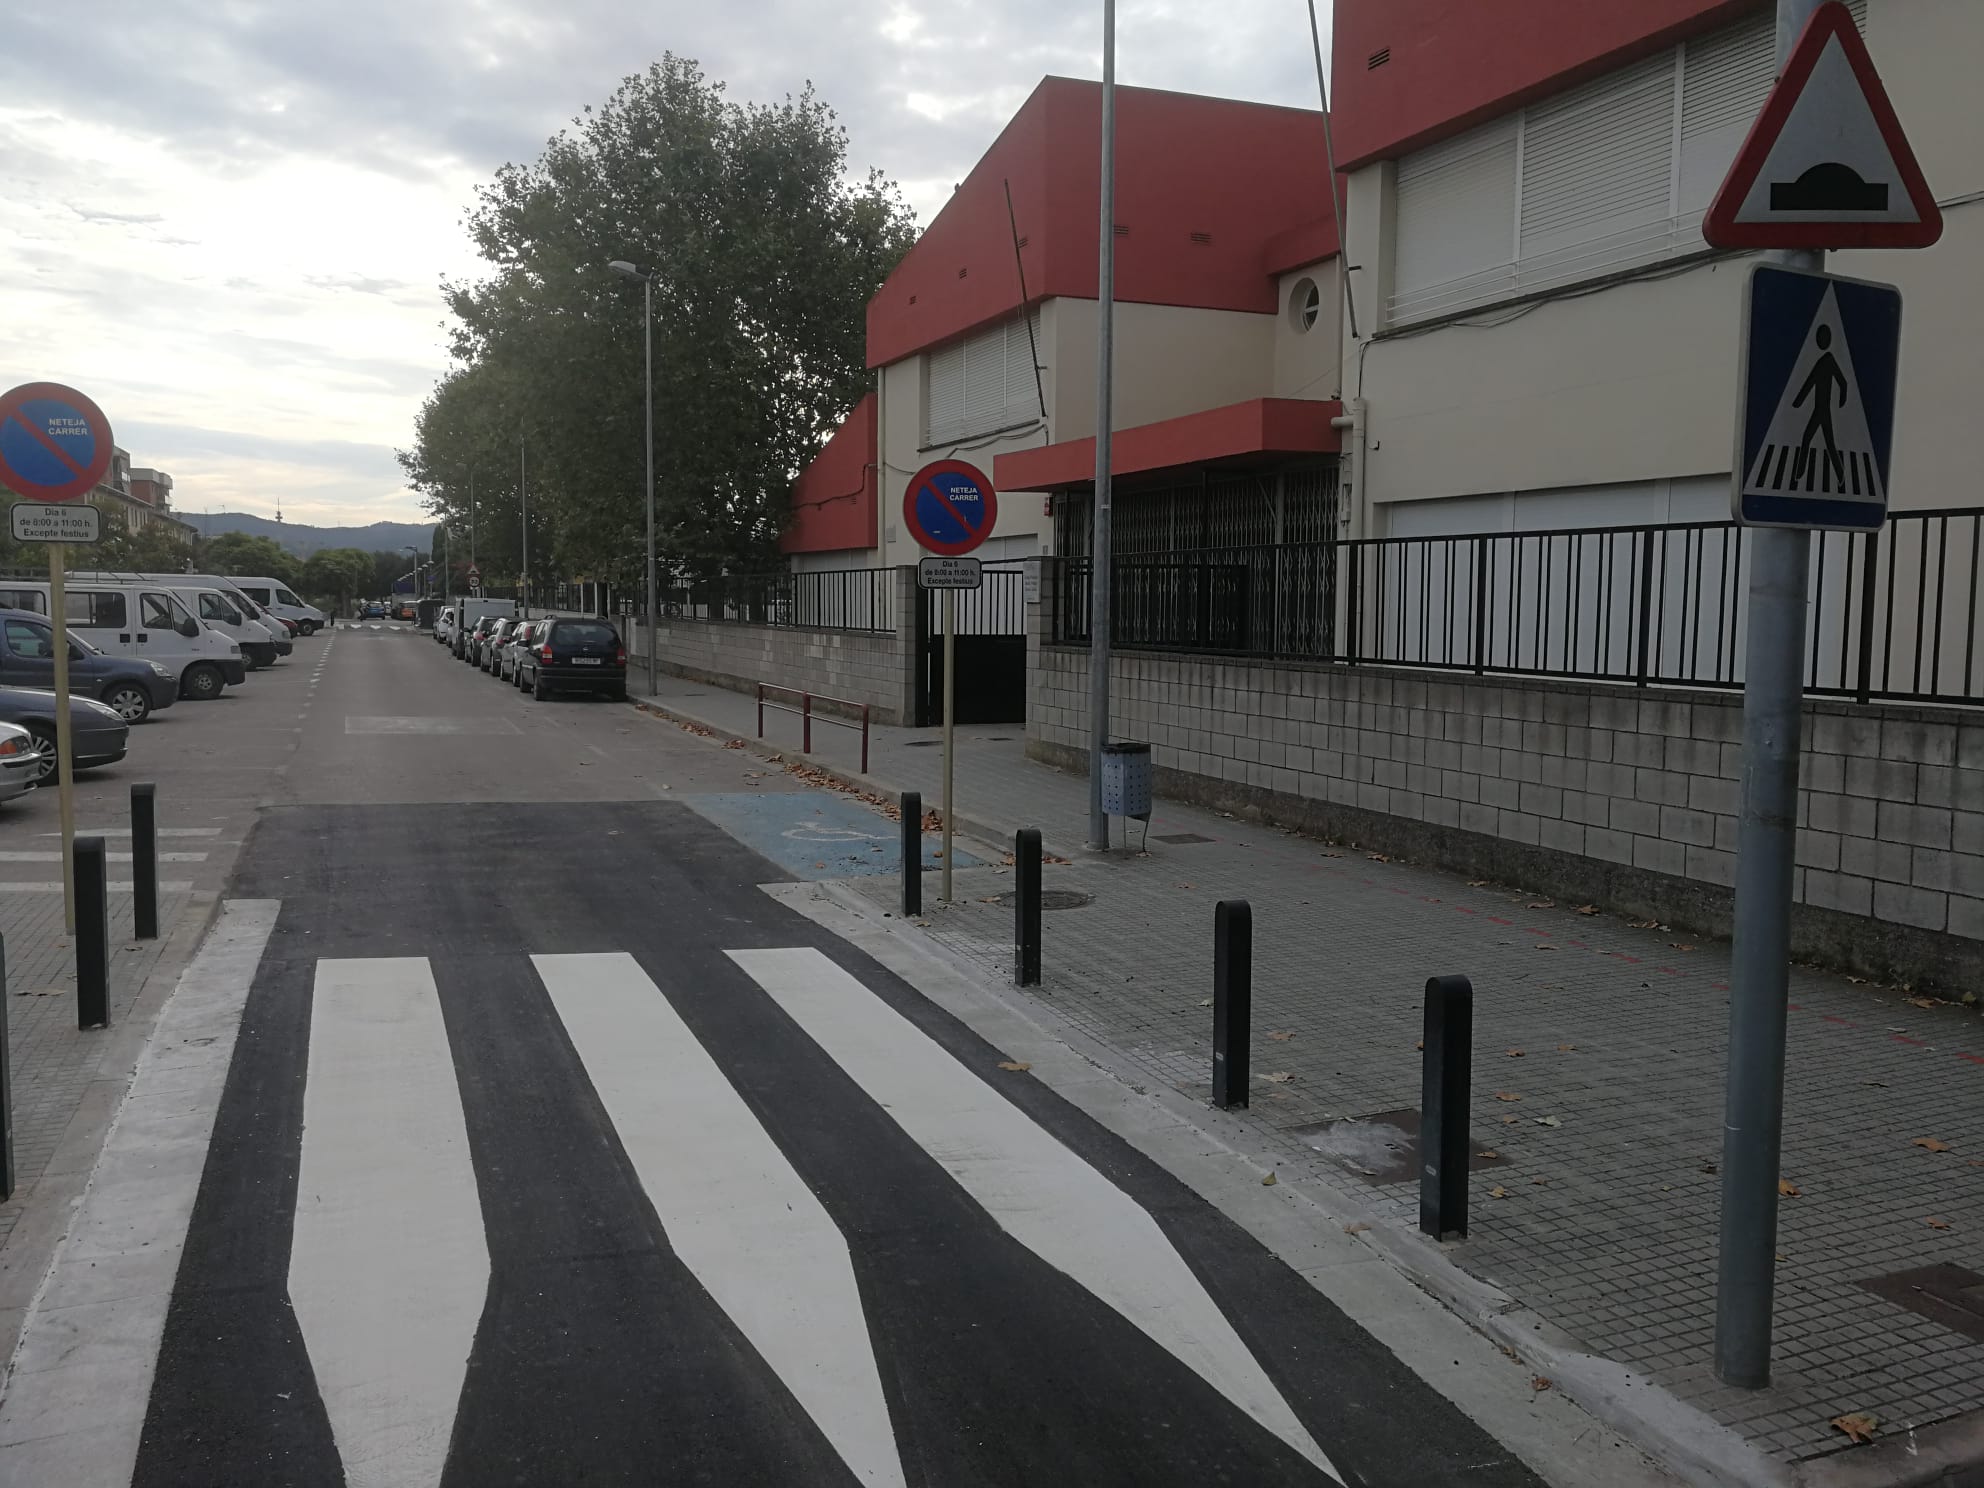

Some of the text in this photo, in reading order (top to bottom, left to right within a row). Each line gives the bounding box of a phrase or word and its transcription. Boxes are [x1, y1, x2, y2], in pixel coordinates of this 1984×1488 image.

[49, 418, 85, 426] NETEJA
[48, 427, 88, 435] CARRER
[24, 528, 88, 538] Excepte festius
